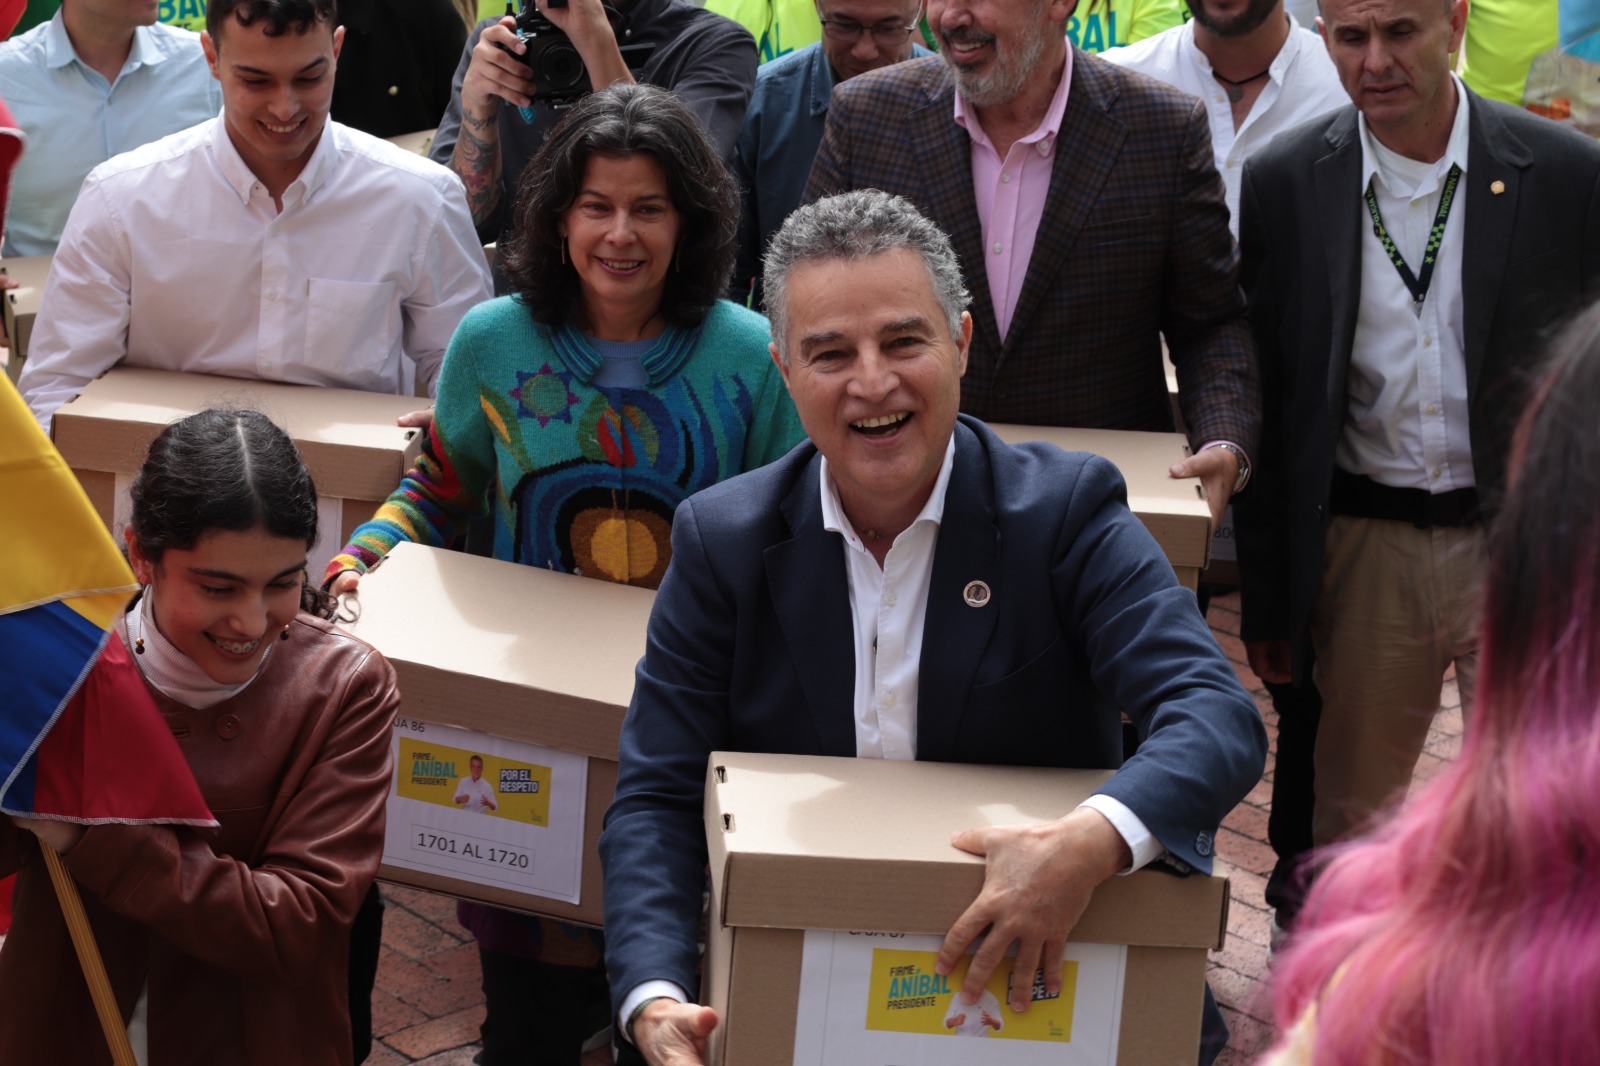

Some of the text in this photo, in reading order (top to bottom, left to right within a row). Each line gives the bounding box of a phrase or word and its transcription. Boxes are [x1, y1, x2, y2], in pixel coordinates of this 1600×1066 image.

[411, 721, 425, 733] 86
[412, 752, 431, 761] FIRME
[412, 756, 458, 779] ANÍBAL
[411, 776, 448, 787] PRESIDENTE
[501, 770, 531, 781] POR EL
[500, 781, 538, 792] RESPETO
[418, 833, 529, 868] 1701 AL 1720
[890, 965, 915, 977] FIRME
[888, 968, 952, 999] ANÍBAL
[886, 996, 936, 1010] PRESIDENTE
